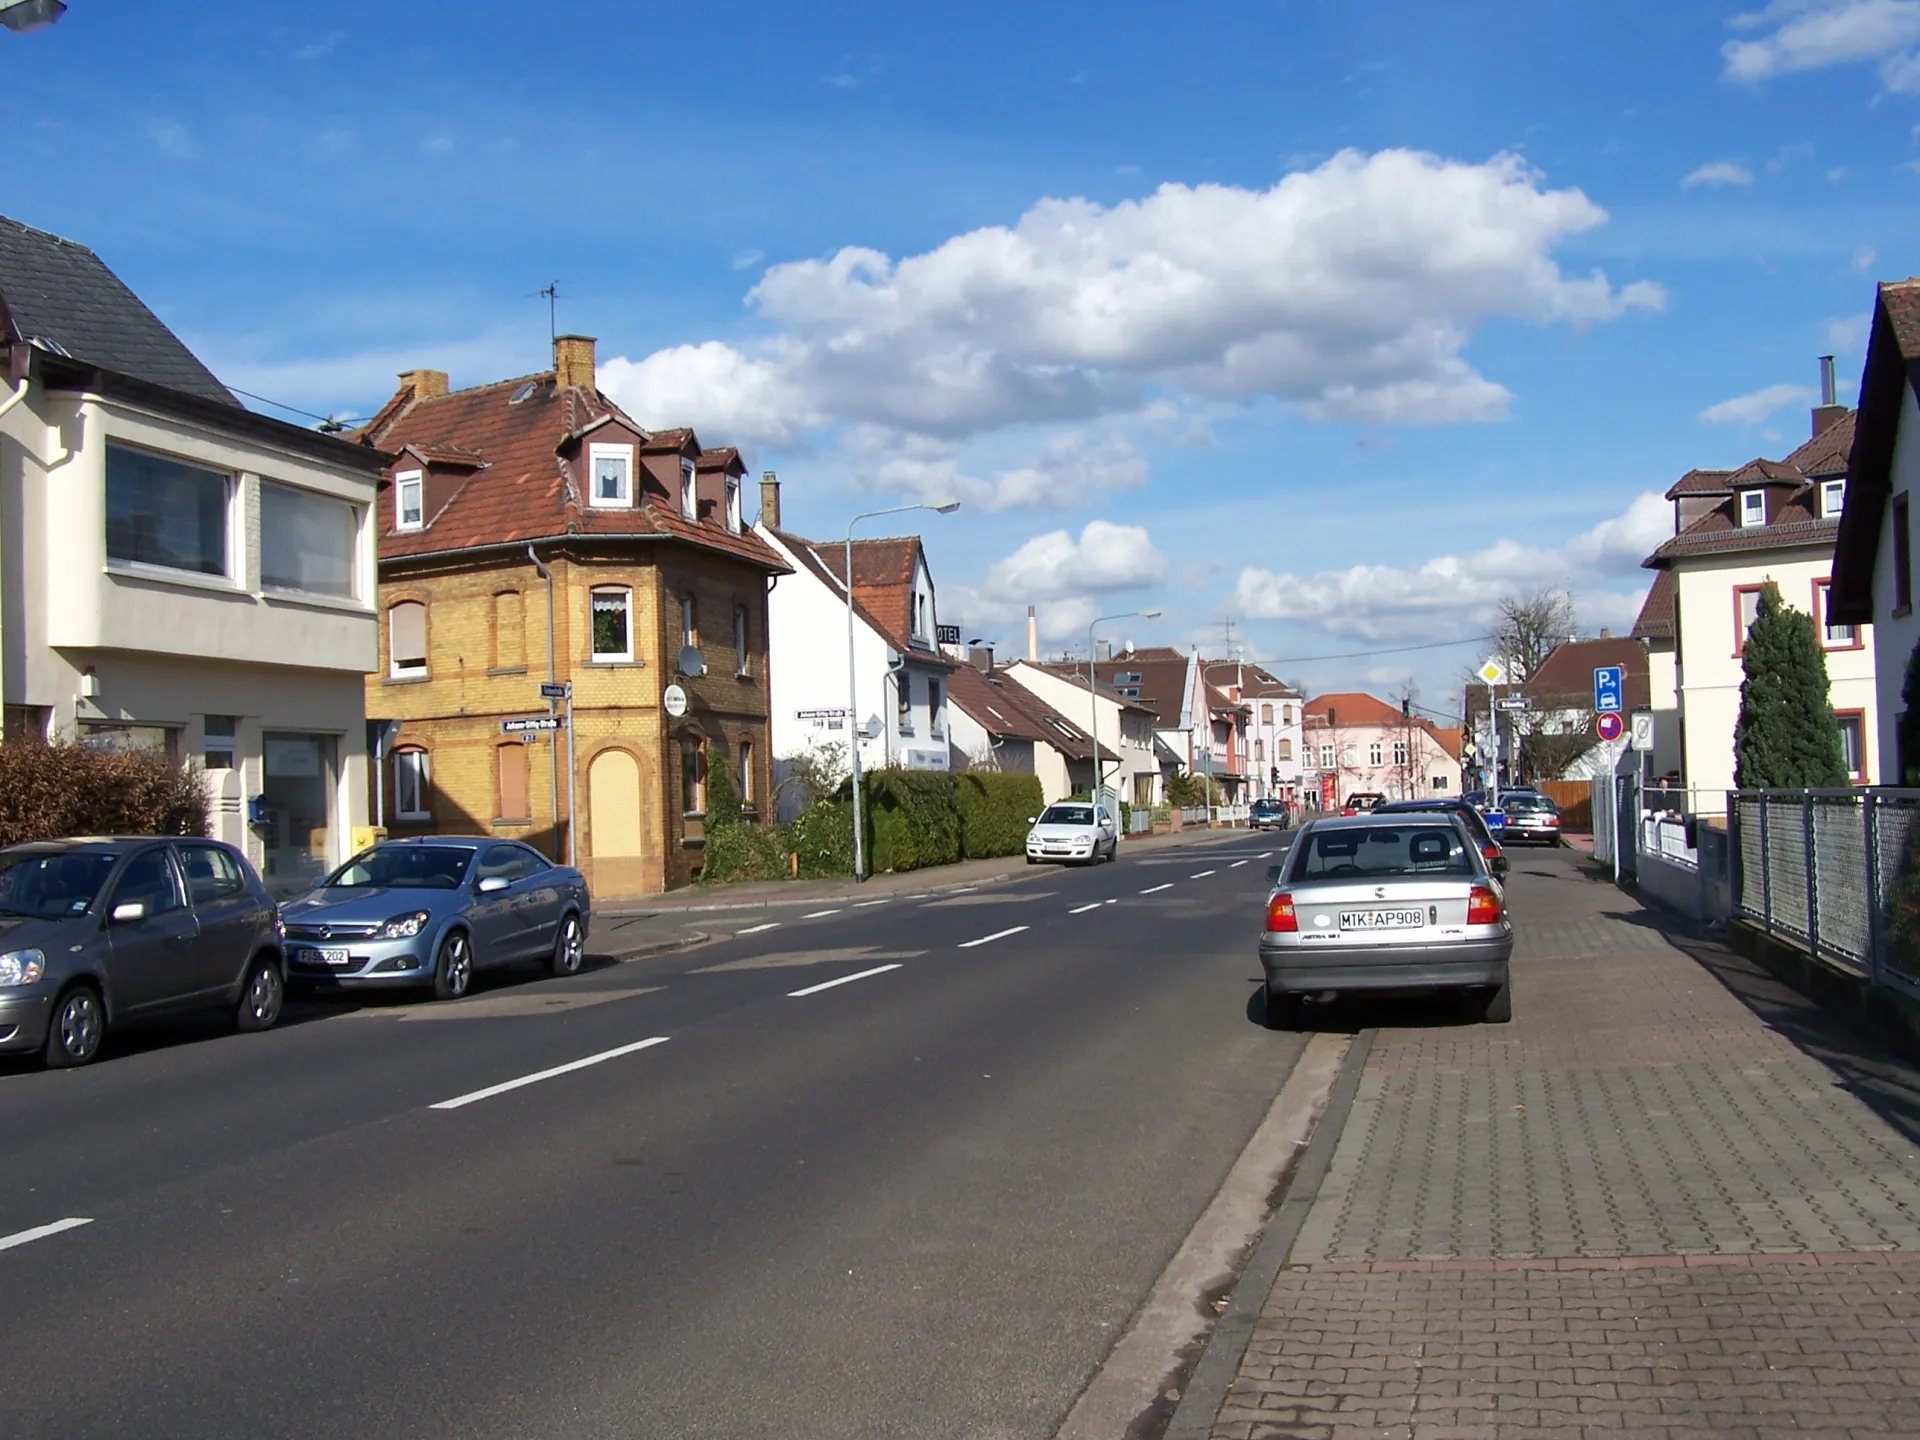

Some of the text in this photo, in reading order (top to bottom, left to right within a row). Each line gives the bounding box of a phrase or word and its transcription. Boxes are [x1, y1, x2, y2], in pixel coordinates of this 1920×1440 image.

[937, 627, 959, 642] OTEL
[1598, 671, 1610, 689] P
[1341, 913, 1367, 926] MTK
[326, 951, 344, 961] 202
